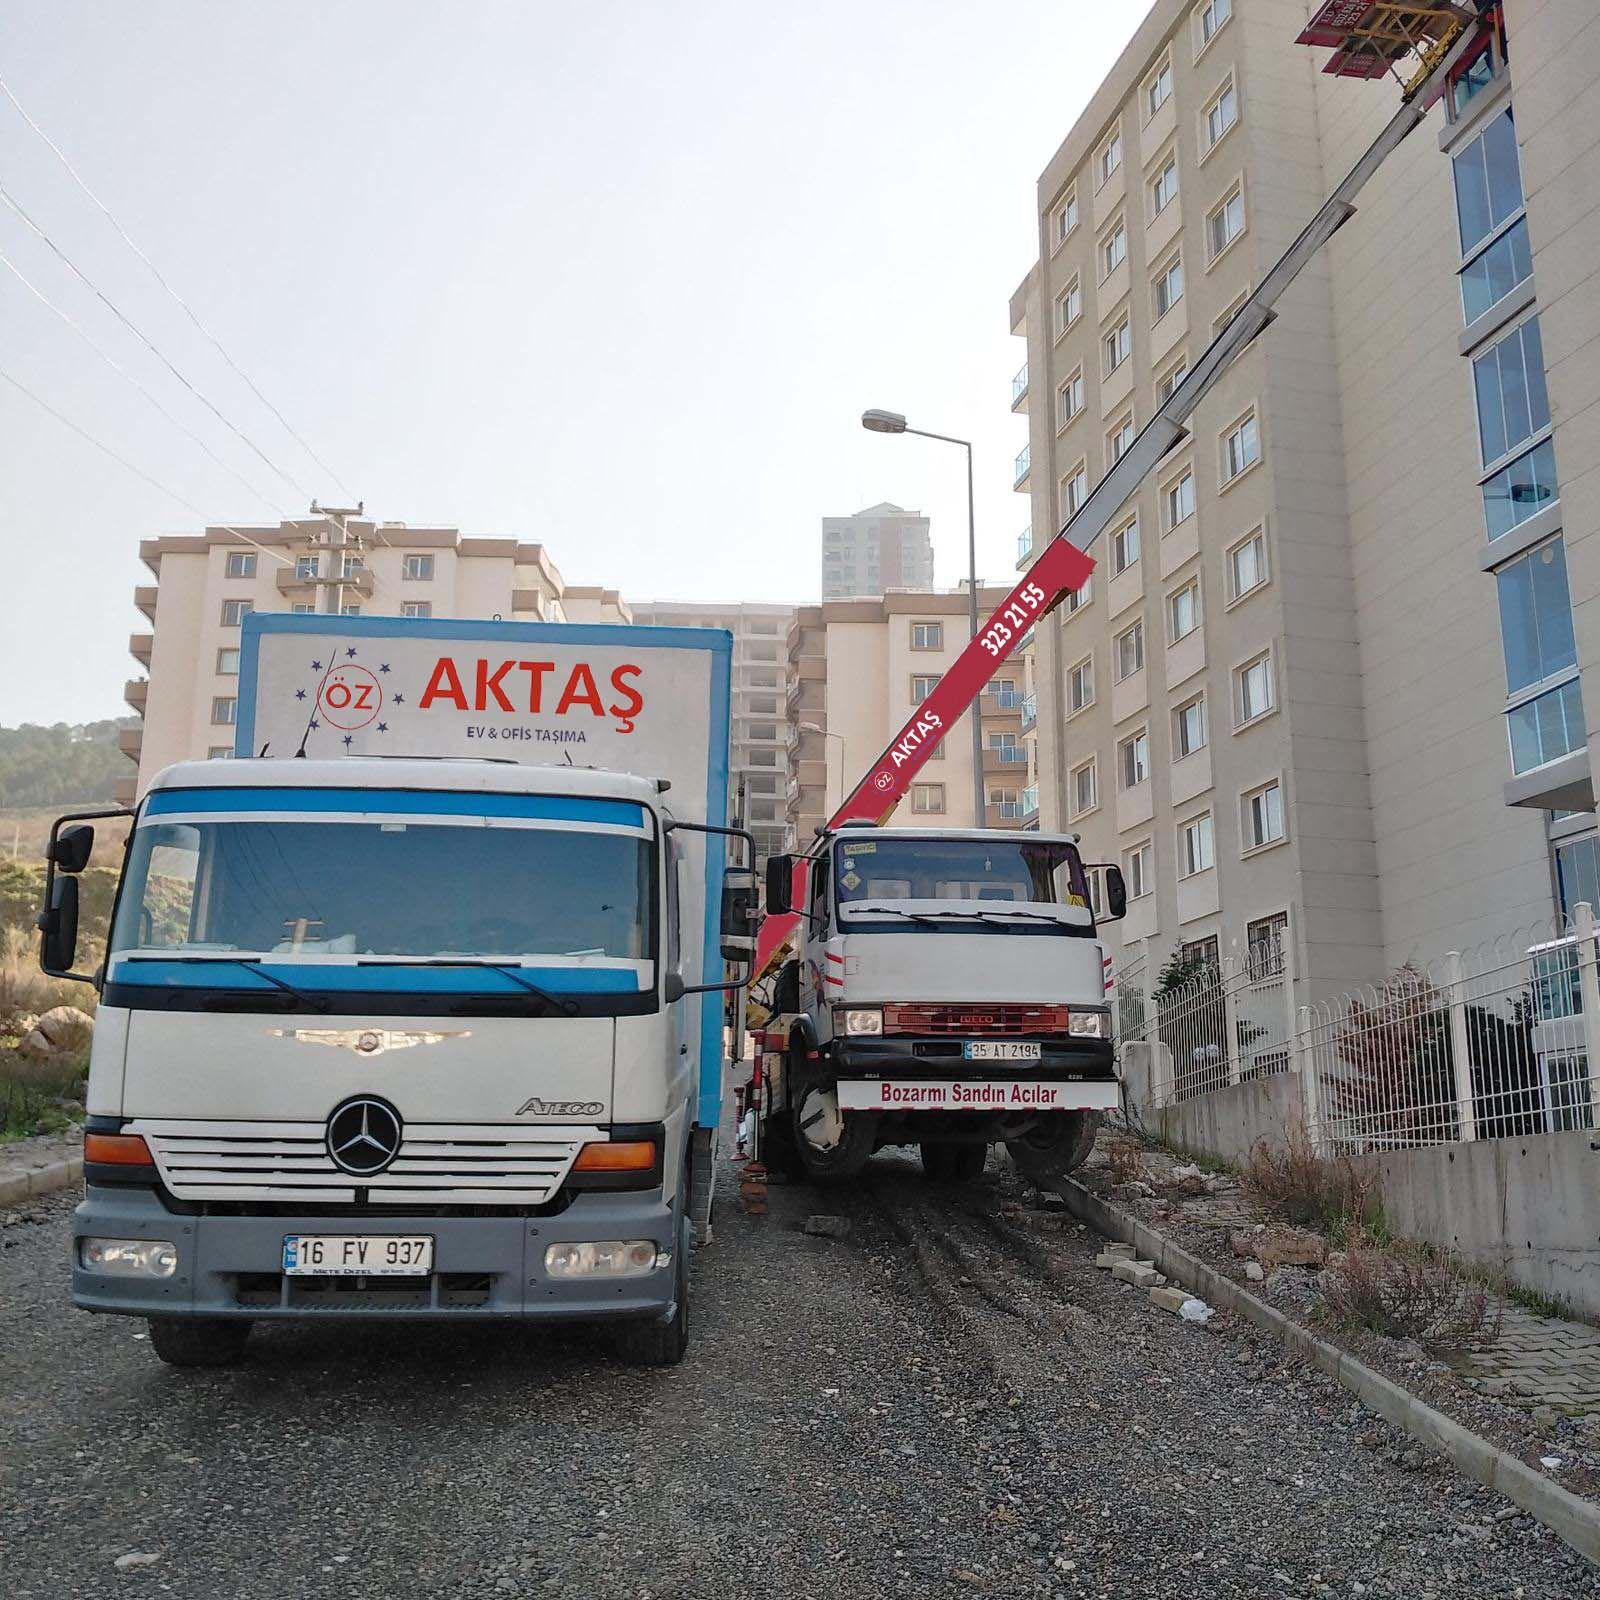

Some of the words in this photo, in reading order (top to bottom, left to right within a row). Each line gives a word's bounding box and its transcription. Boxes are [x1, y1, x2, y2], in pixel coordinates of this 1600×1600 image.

[980, 622, 1012, 656] 323
[1003, 602, 1028, 629] 21
[1019, 582, 1045, 609] 55
[325, 676, 373, 709] ÖZ
[419, 657, 643, 734] AKTAŞ
[467, 726, 485, 738] EV
[488, 727, 498, 739] &
[501, 725, 532, 740] OFİS
[535, 729, 587, 744] TAŞIMA
[890, 710, 943, 768] AKTAŞ
[876, 773, 892, 789] ÖZ
[960, 1015, 993, 1023] IVECO
[973, 1044, 990, 1057] 35
[993, 1044, 1007, 1057] AT
[1011, 1044, 1038, 1057] 2194
[881, 1082, 946, 1102] Bozarmı
[952, 1083, 1005, 1102] Sandın
[1010, 1084, 1057, 1103] Acılar
[301, 1241, 324, 1264] 16
[343, 1241, 368, 1264] FV
[386, 1241, 425, 1264] 937
